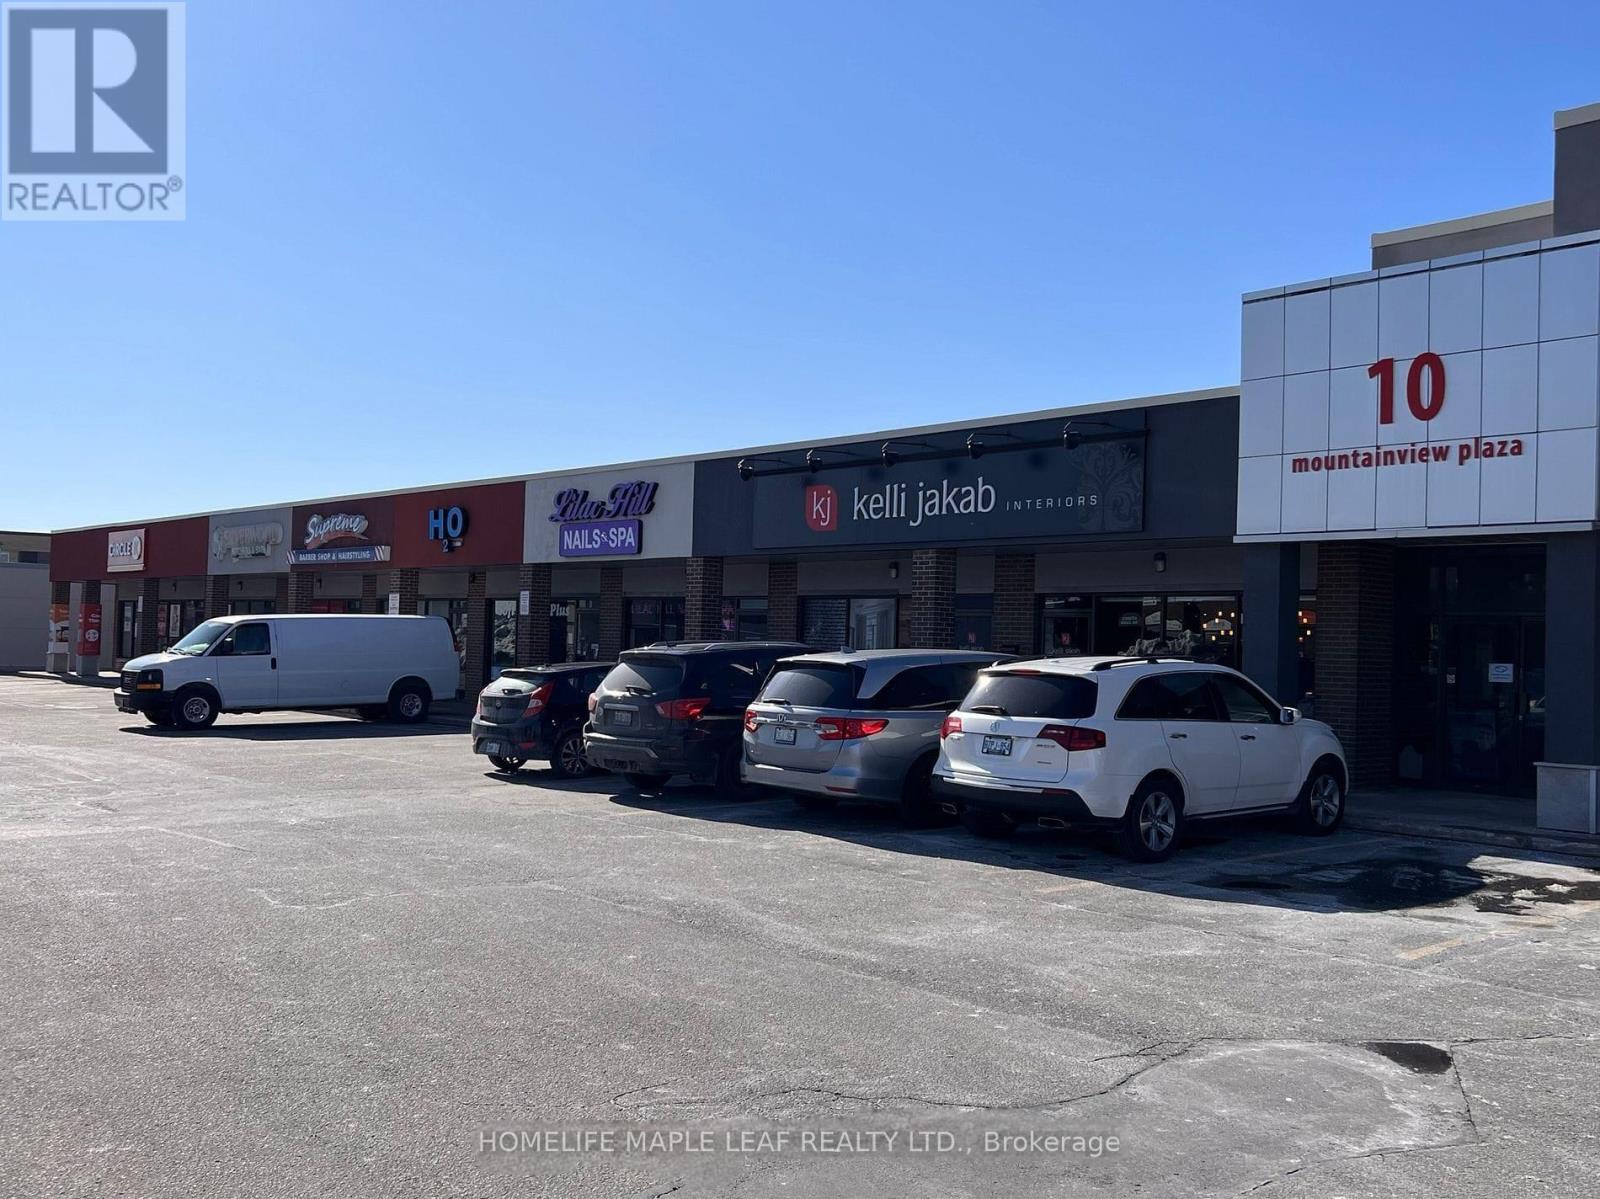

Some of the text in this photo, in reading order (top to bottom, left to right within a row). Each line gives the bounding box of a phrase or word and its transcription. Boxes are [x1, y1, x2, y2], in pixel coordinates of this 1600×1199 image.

[1367, 352, 1446, 424] 10
[1291, 436, 1524, 473] mountainview plaza
[548, 481, 659, 522] Lilac Hill
[812, 490, 832, 526] kj
[853, 476, 1098, 527] kelli jakab INTERIORS
[304, 515, 368, 544] Supreme
[563, 529, 600, 550] NAILS
[609, 526, 636, 549] SPA
[299, 553, 317, 561] BARBER
[317, 552, 331, 561] SHOP
[338, 550, 371, 561] HAIRSTYLING
